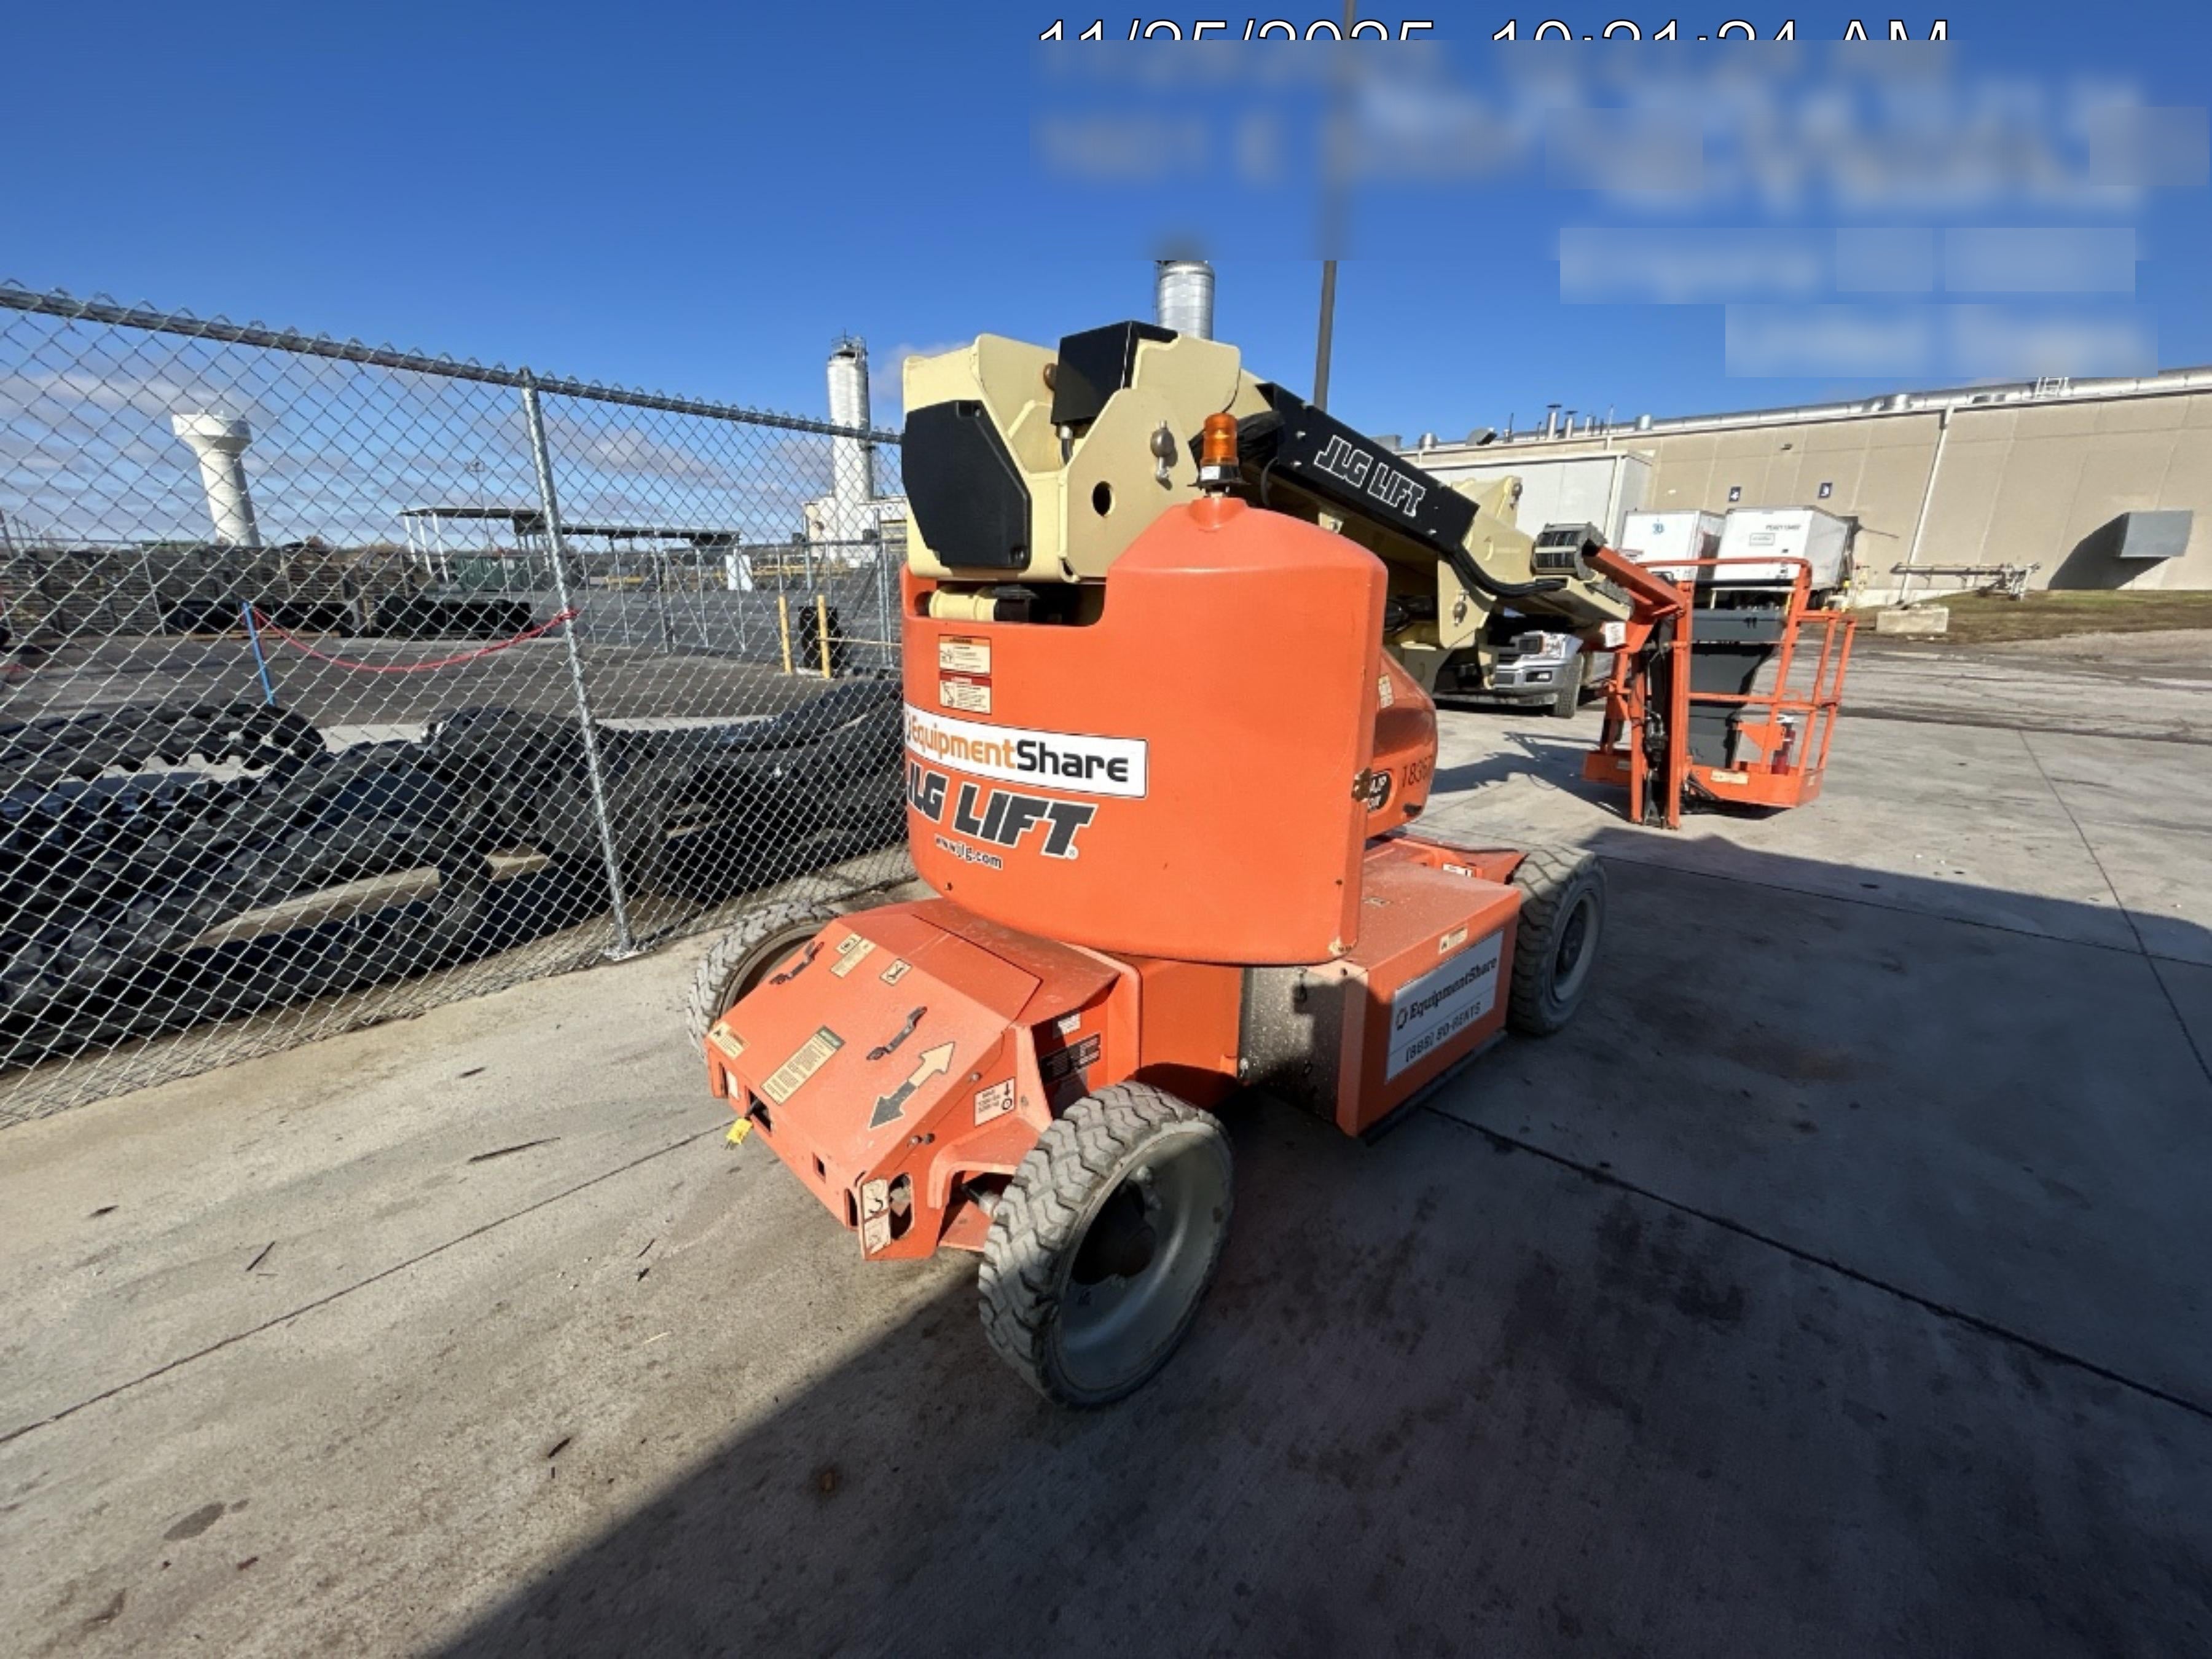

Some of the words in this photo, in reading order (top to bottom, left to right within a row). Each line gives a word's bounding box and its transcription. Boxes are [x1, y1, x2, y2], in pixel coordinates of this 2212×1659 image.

[1314, 434, 1374, 488] JLG
[1367, 462, 1427, 517] LIFT
[911, 715, 1128, 782] EquipmentShare
[908, 759, 949, 823] JLG
[1410, 957, 1497, 1020] EquipmentShare
